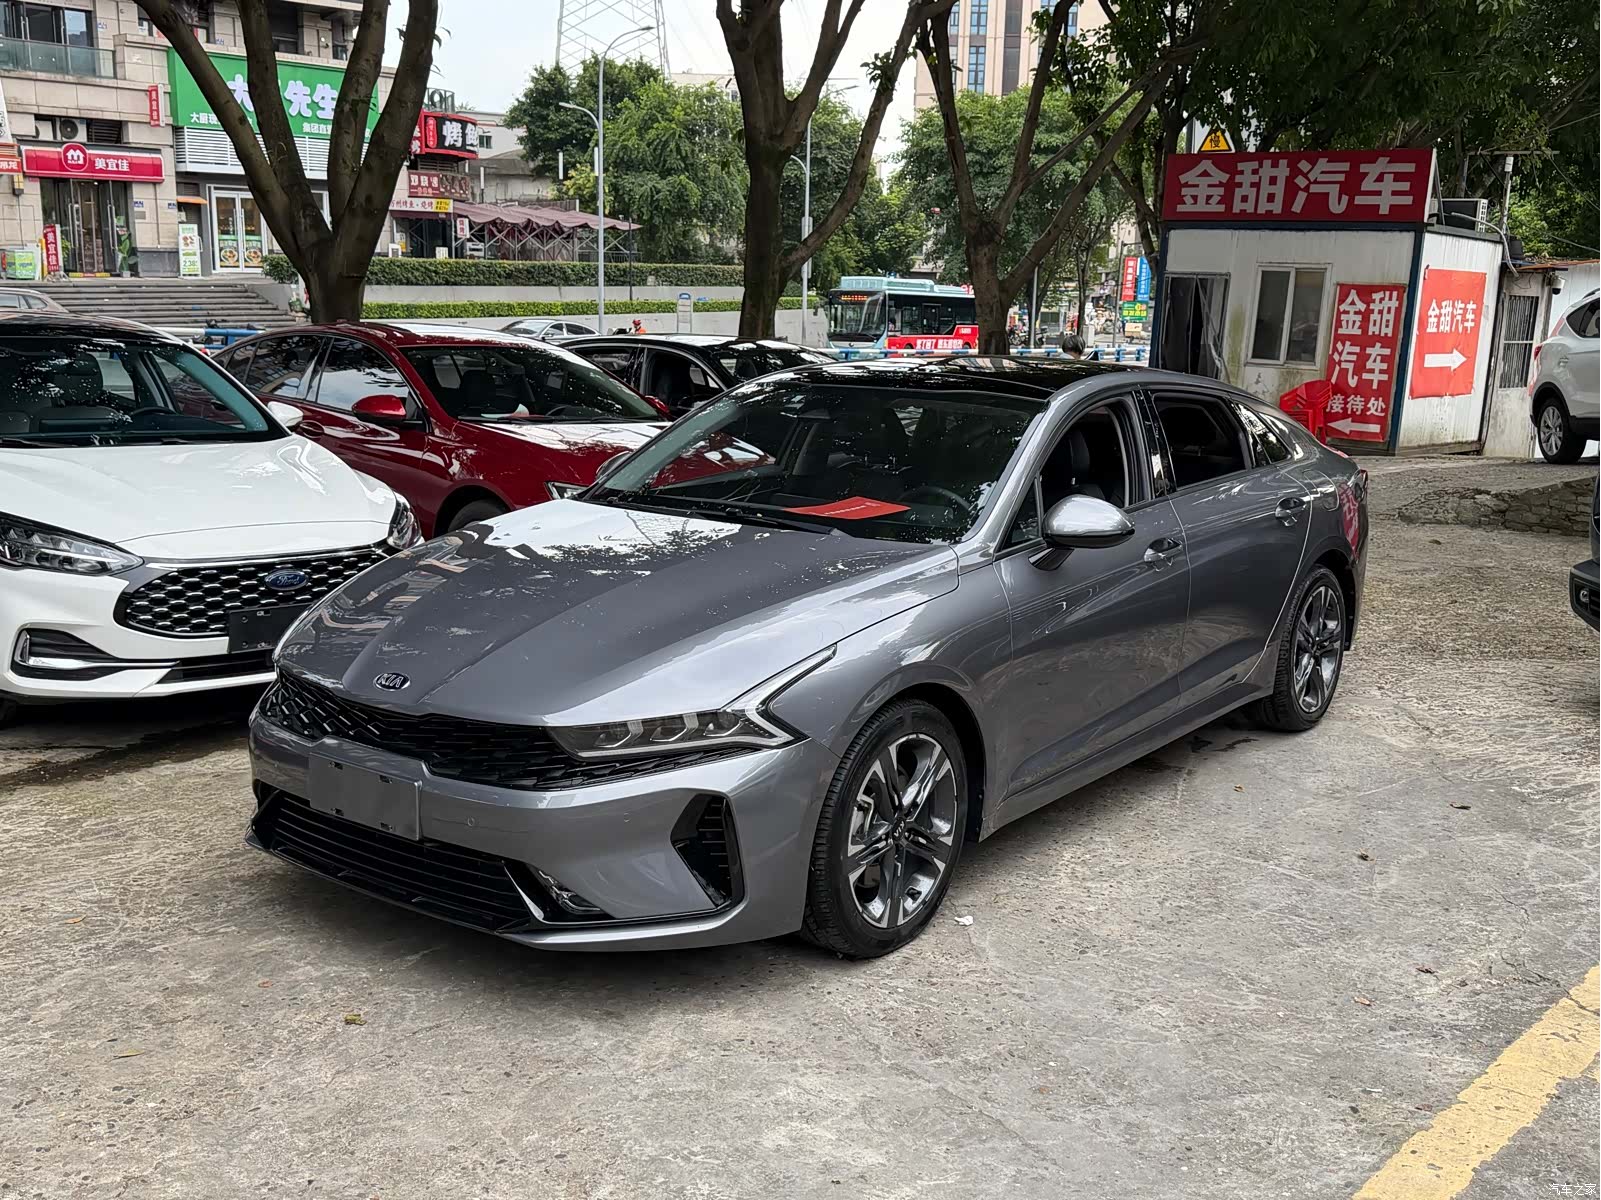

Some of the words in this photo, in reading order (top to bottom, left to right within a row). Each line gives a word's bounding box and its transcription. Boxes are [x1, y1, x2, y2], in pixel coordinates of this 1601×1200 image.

[1209, 135, 1220, 149] 慢
[95, 158, 130, 171] 美宜佳
[1176, 157, 1416, 215] 金甜汽车
[1338, 289, 1399, 337] 金甜
[1426, 299, 1477, 334] 金甜汽车
[1331, 341, 1391, 390] 汽车
[1326, 394, 1386, 417] 接待处
[377, 673, 404, 688] KIA
